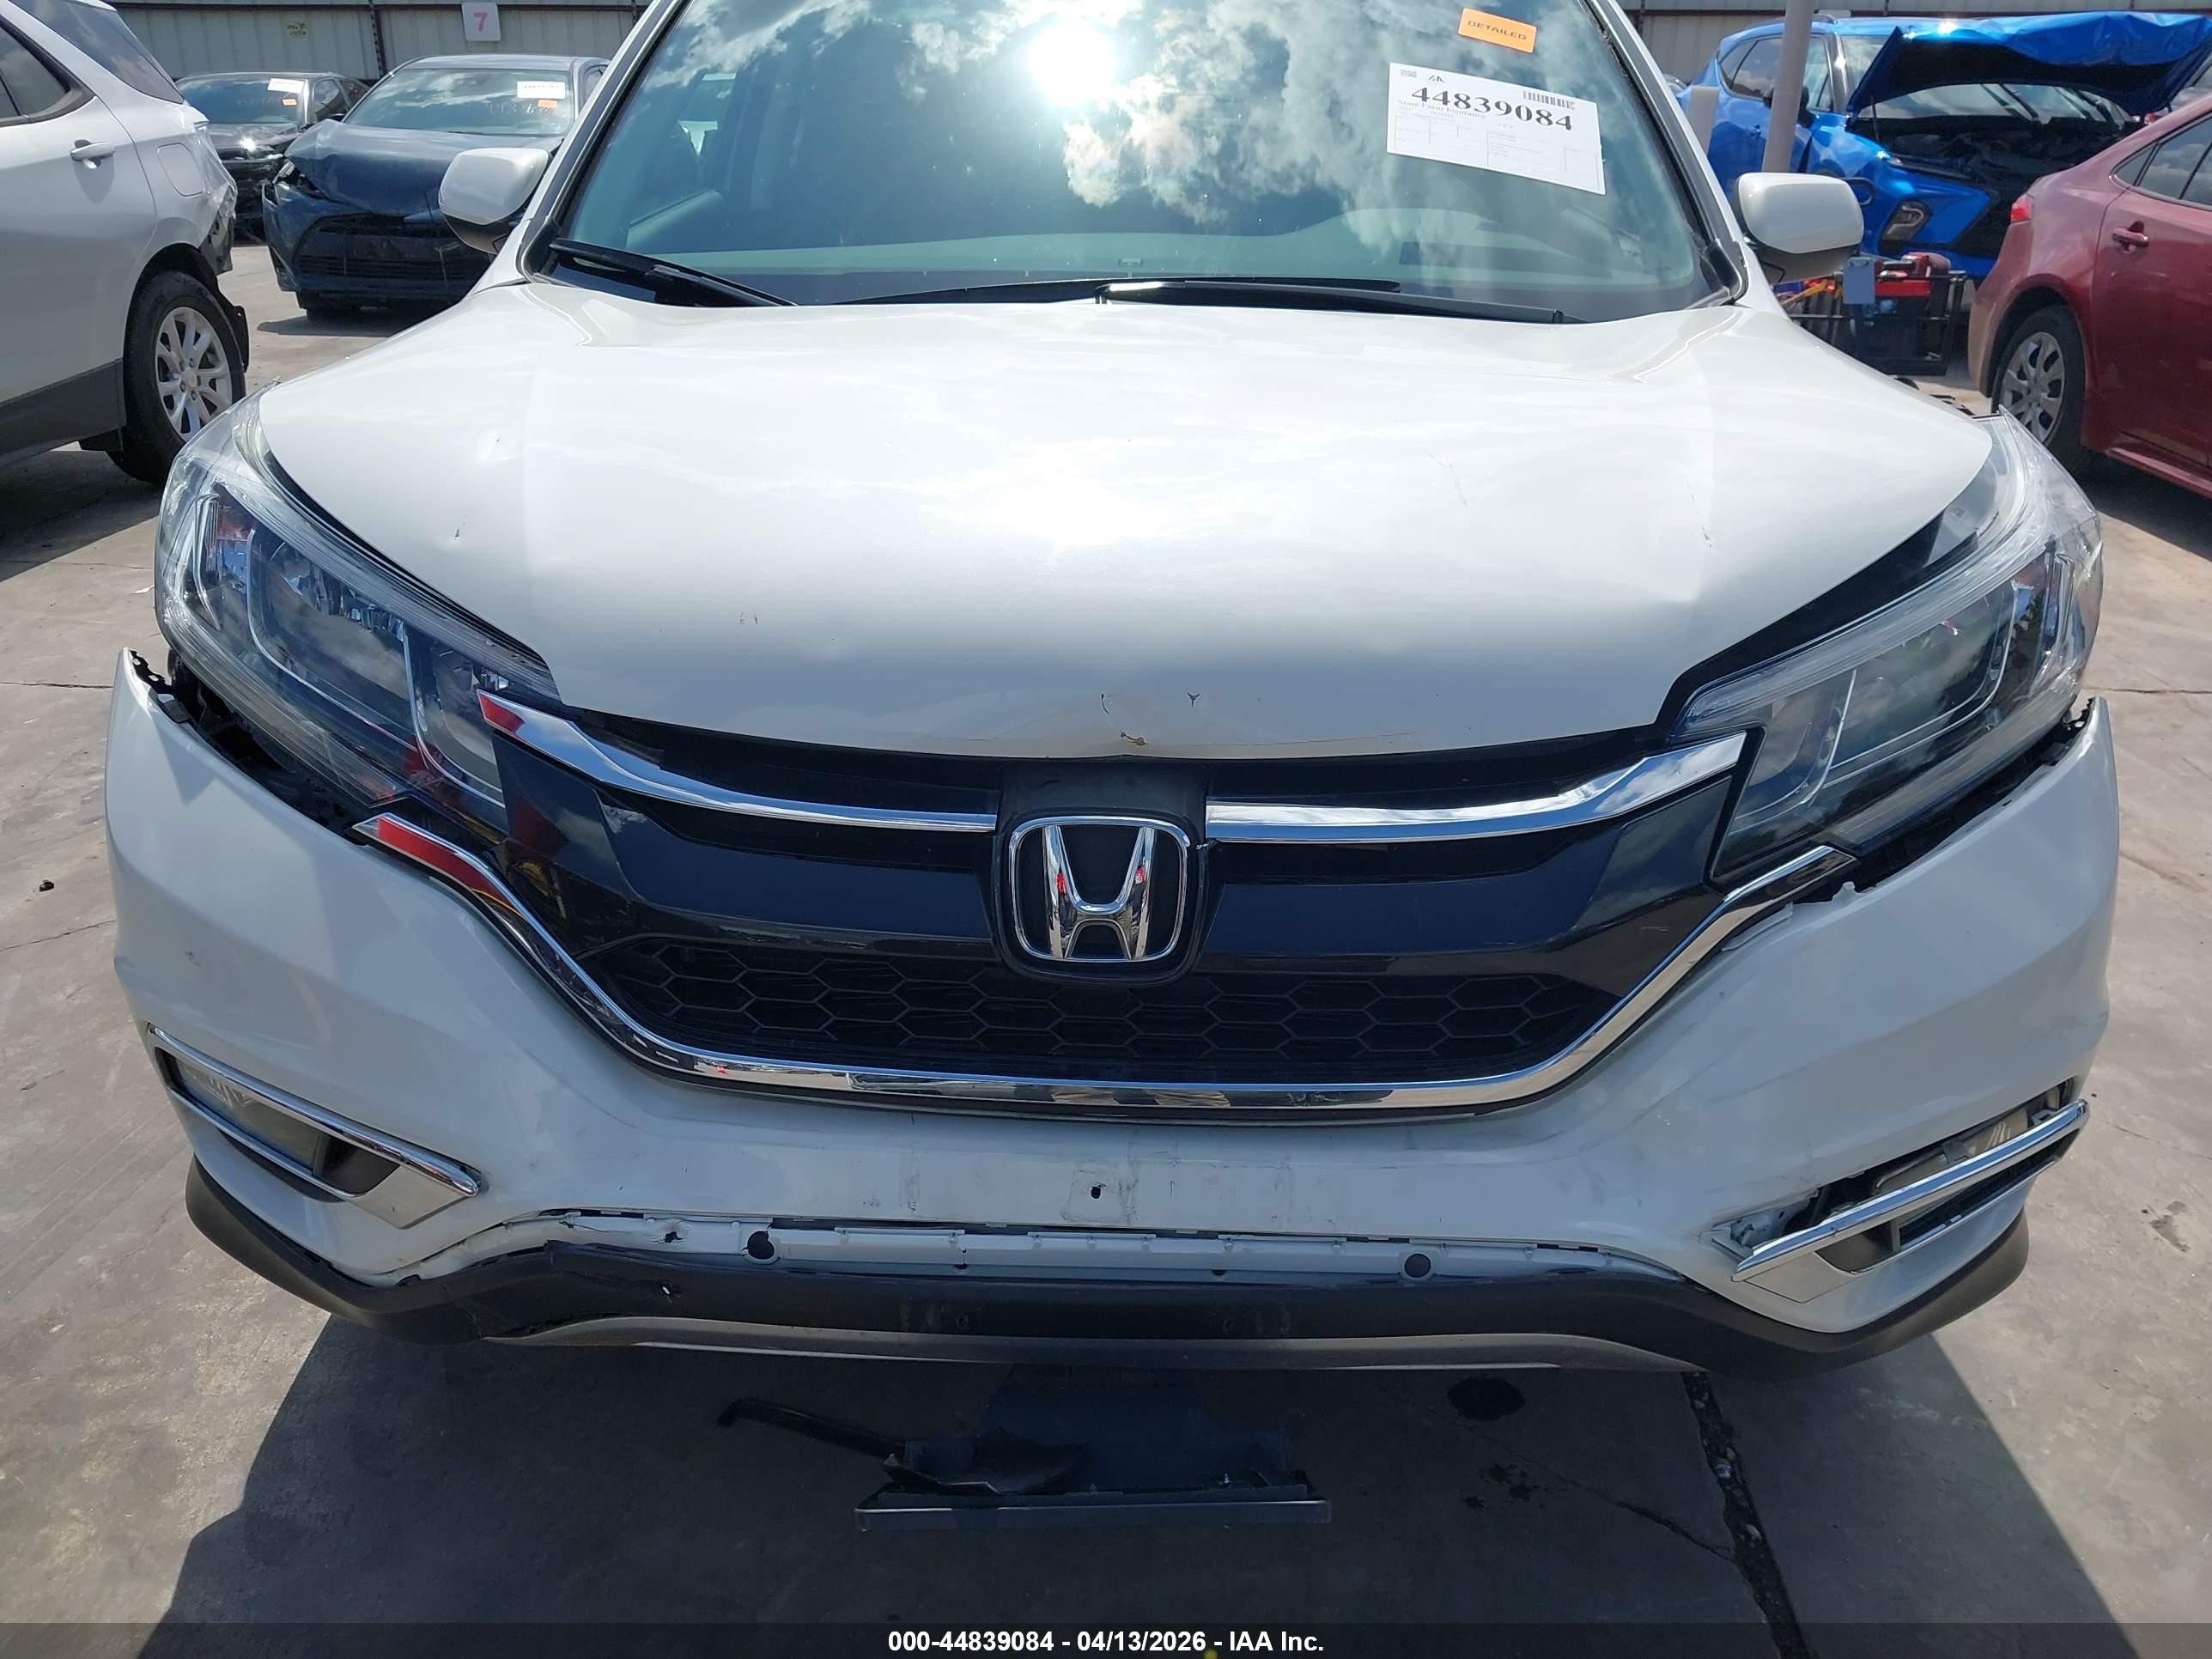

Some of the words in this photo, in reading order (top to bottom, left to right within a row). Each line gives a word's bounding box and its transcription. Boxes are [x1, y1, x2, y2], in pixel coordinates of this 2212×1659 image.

[473, 12, 488, 32] 7
[1468, 20, 1527, 40] DETAILED
[1411, 87, 1572, 131] 44839084
